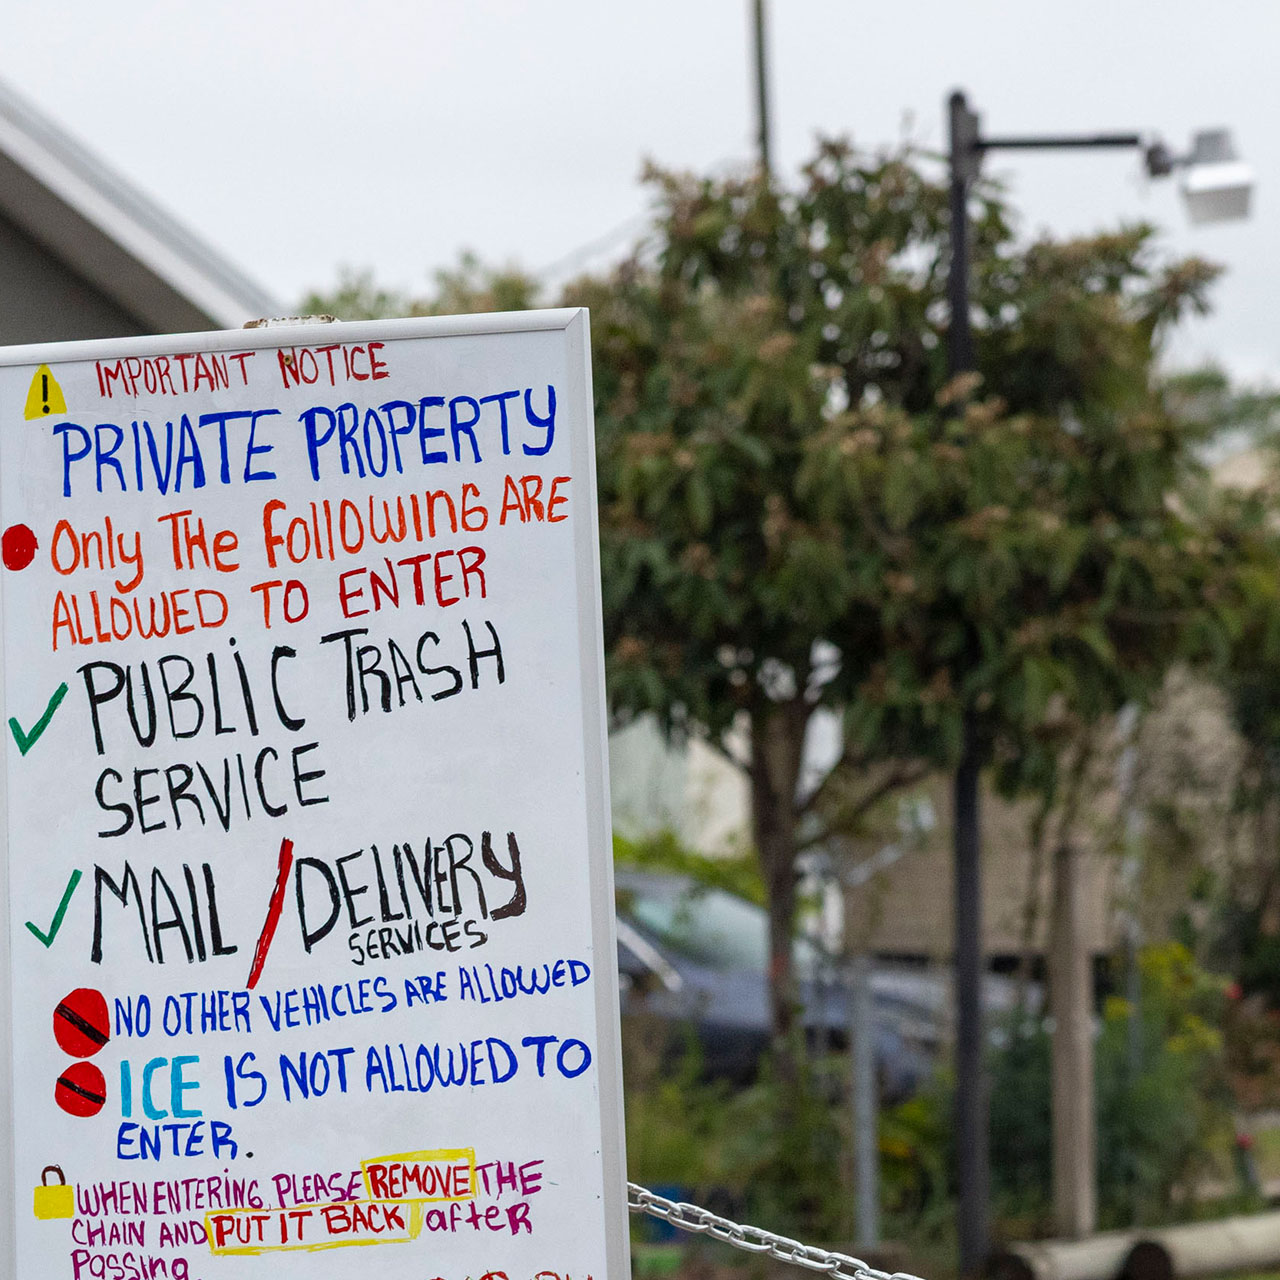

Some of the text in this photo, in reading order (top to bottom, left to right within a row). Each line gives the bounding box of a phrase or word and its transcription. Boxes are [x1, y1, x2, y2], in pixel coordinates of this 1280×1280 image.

[95, 342, 390, 398] IMPORTANT NOTICE
[53, 385, 556, 497] PRIVATE PROPERTY
[51, 516, 143, 594] Only
[500, 475, 571, 525] ARE
[53, 546, 486, 651] ALLOWED TO ENTER
[320, 619, 504, 722] TRASH
[95, 742, 329, 838] SERVICE
[349, 918, 487, 966] SERVICES
[115, 960, 590, 1037] NO OTHER VEHICLES ARE ALLOWED
[120, 1035, 591, 1120] ICE IS NOT ALLOWED TO
[117, 1121, 253, 1161] ENTER.
[72, 1219, 144, 1247] CHAIN
[160, 1221, 208, 1248] AND
[211, 1216, 270, 1248] PUT
[280, 1211, 312, 1243] IT
[320, 1203, 405, 1234] BACK
[77, 1181, 147, 1216] WHEN
[272, 1171, 363, 1210] PLEASE
[366, 1164, 472, 1198] REMOVE
[474, 1160, 543, 1200] THE
